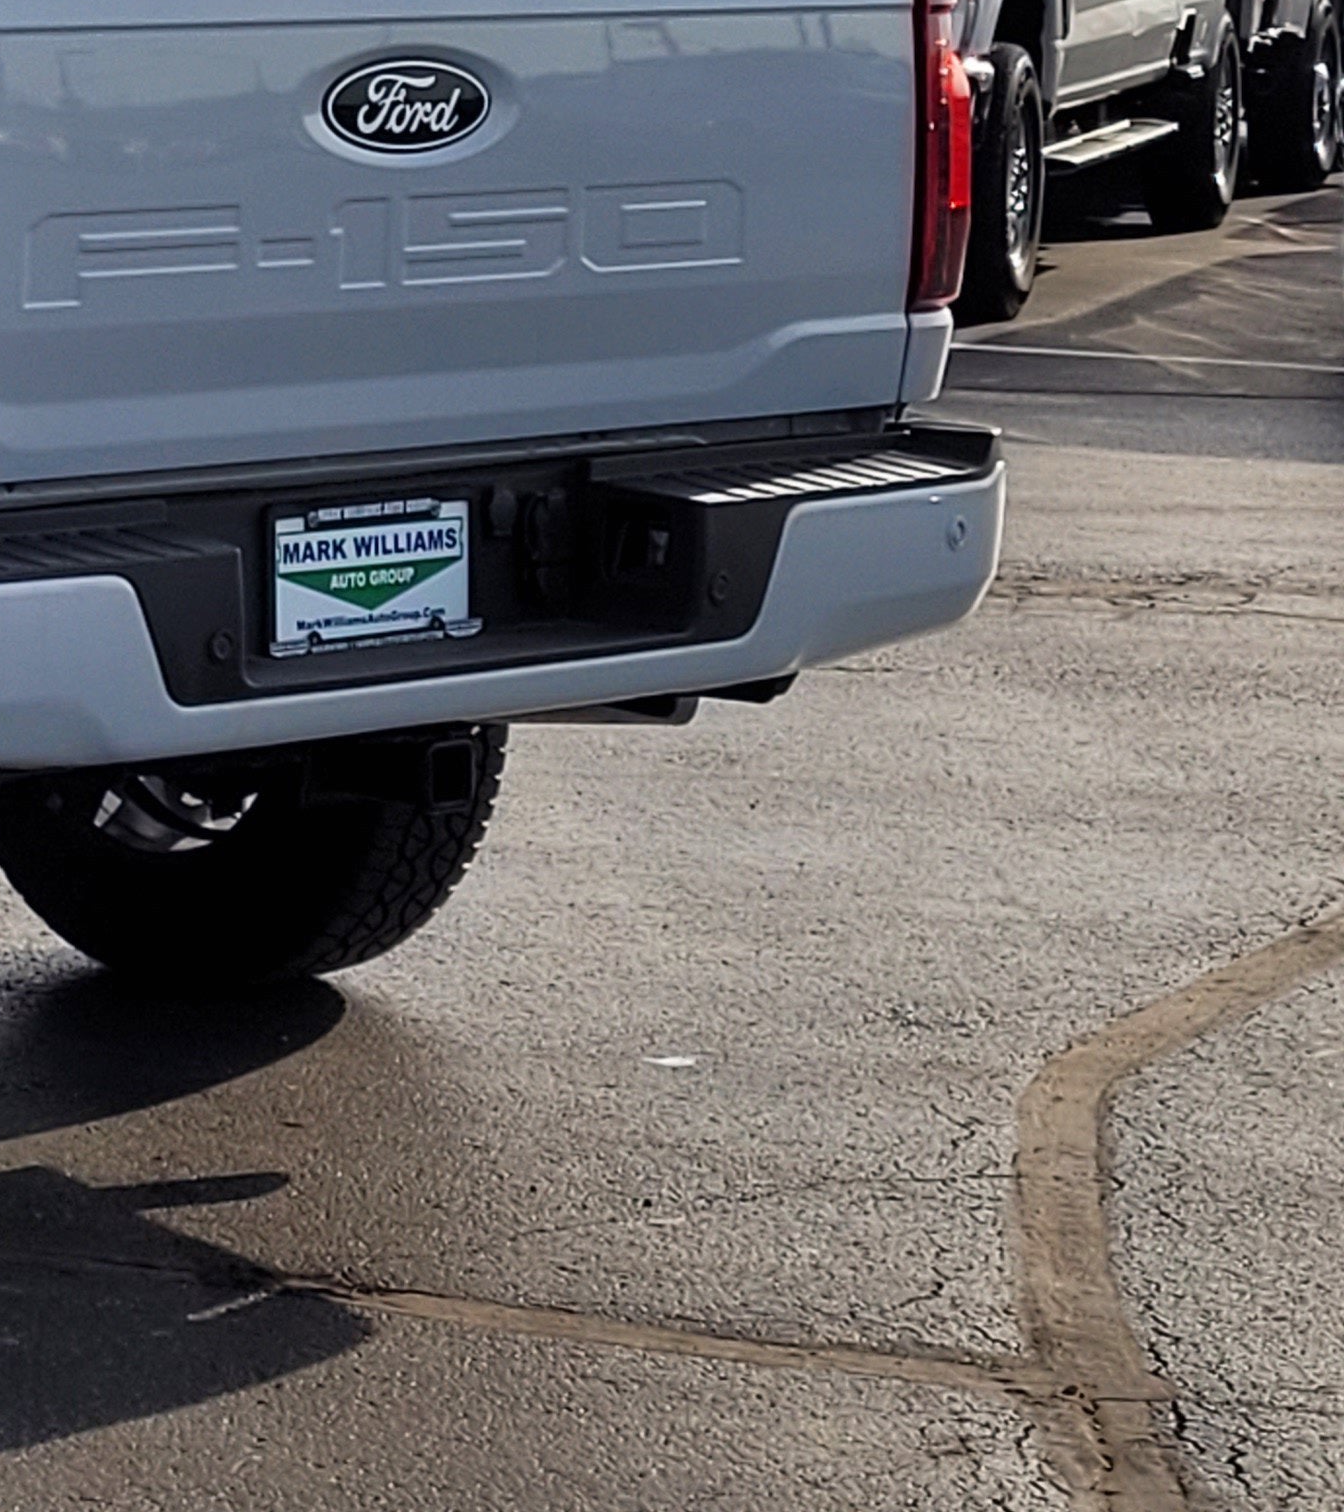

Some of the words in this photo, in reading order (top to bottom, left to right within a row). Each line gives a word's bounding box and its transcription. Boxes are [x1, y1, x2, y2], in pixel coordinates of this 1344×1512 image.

[356, 73, 461, 134] Ford
[22, 179, 743, 309] F-150
[283, 538, 347, 565] MARK
[353, 528, 458, 557] WILLIAMS
[329, 571, 366, 590] AUTO
[369, 567, 415, 587] GROUP
